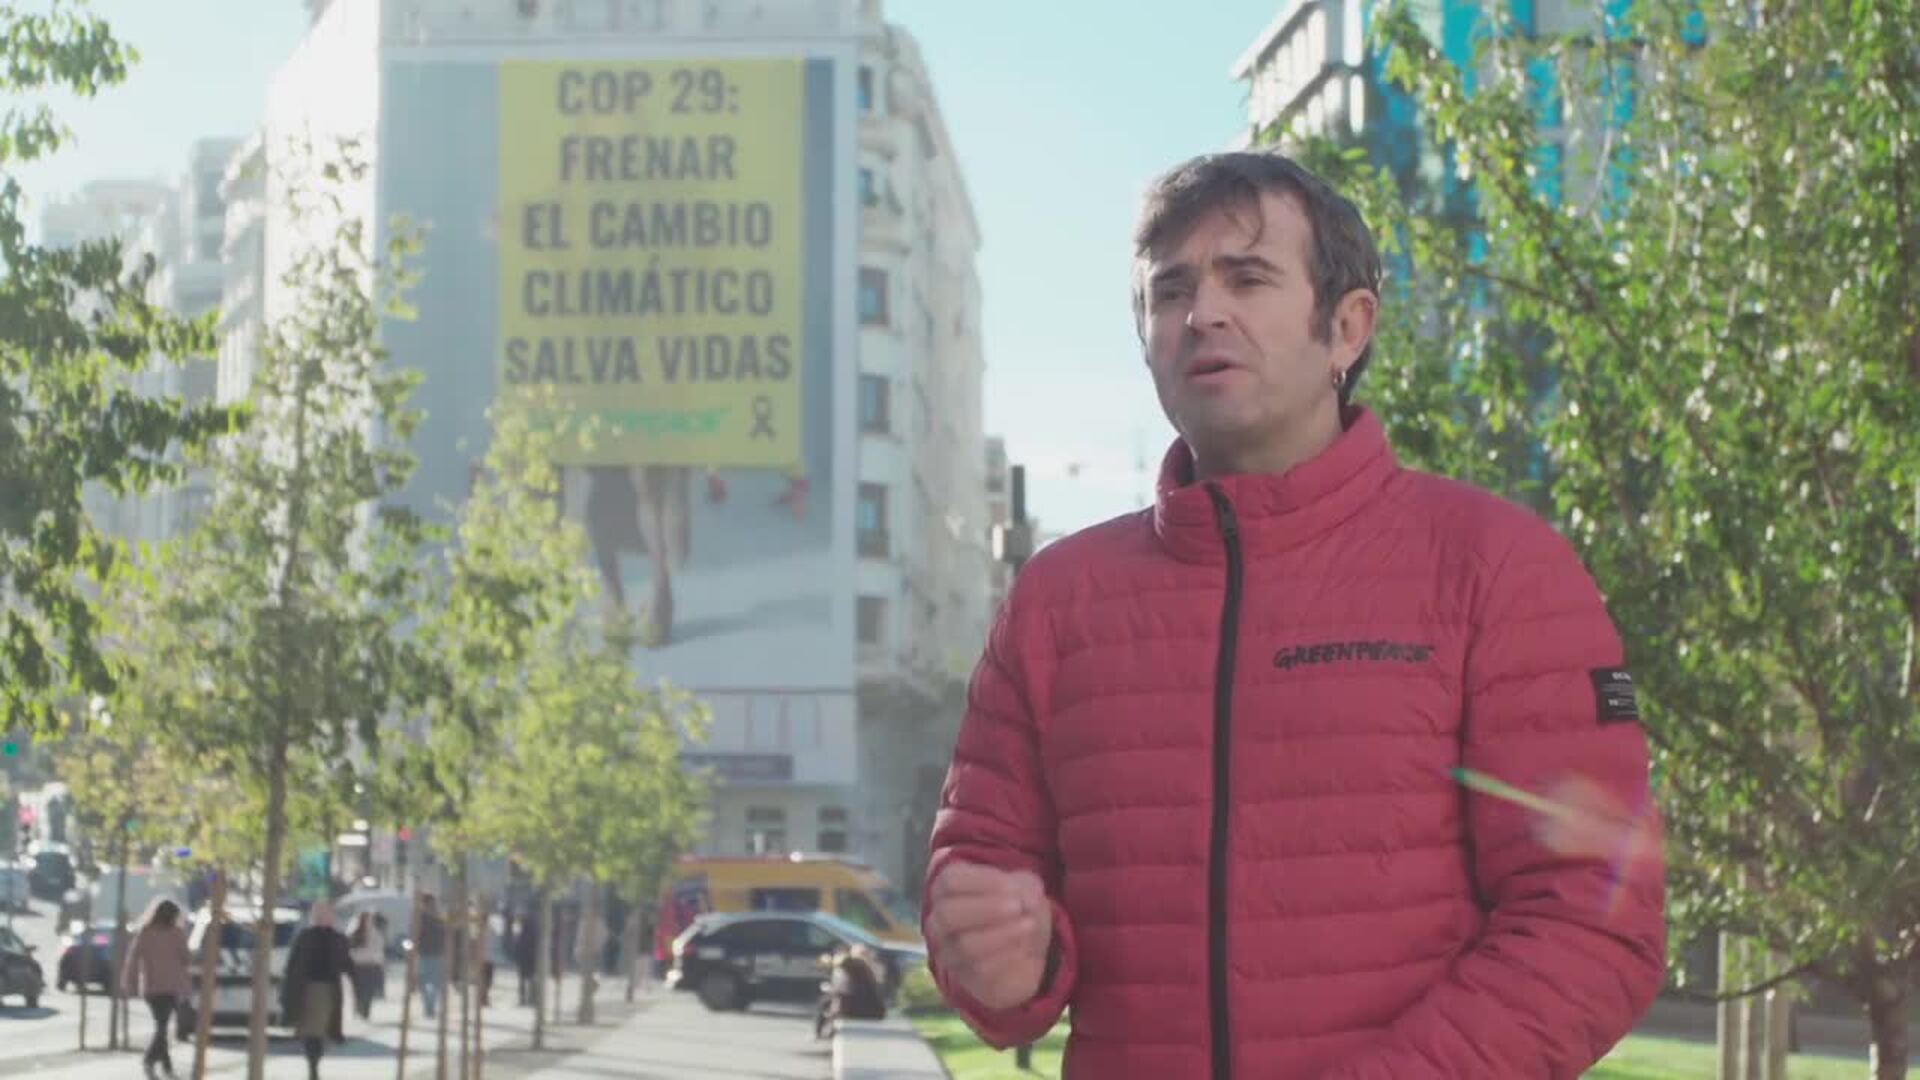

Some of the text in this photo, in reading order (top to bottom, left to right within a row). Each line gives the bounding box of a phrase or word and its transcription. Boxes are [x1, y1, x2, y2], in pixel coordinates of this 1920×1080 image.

[558, 69, 740, 115] COP 29:
[560, 135, 737, 180] FRENAR
[523, 203, 772, 250] EL CAMBIO
[524, 256, 774, 316] CLIMÁTICO
[505, 334, 793, 385] SALVA VIDAS
